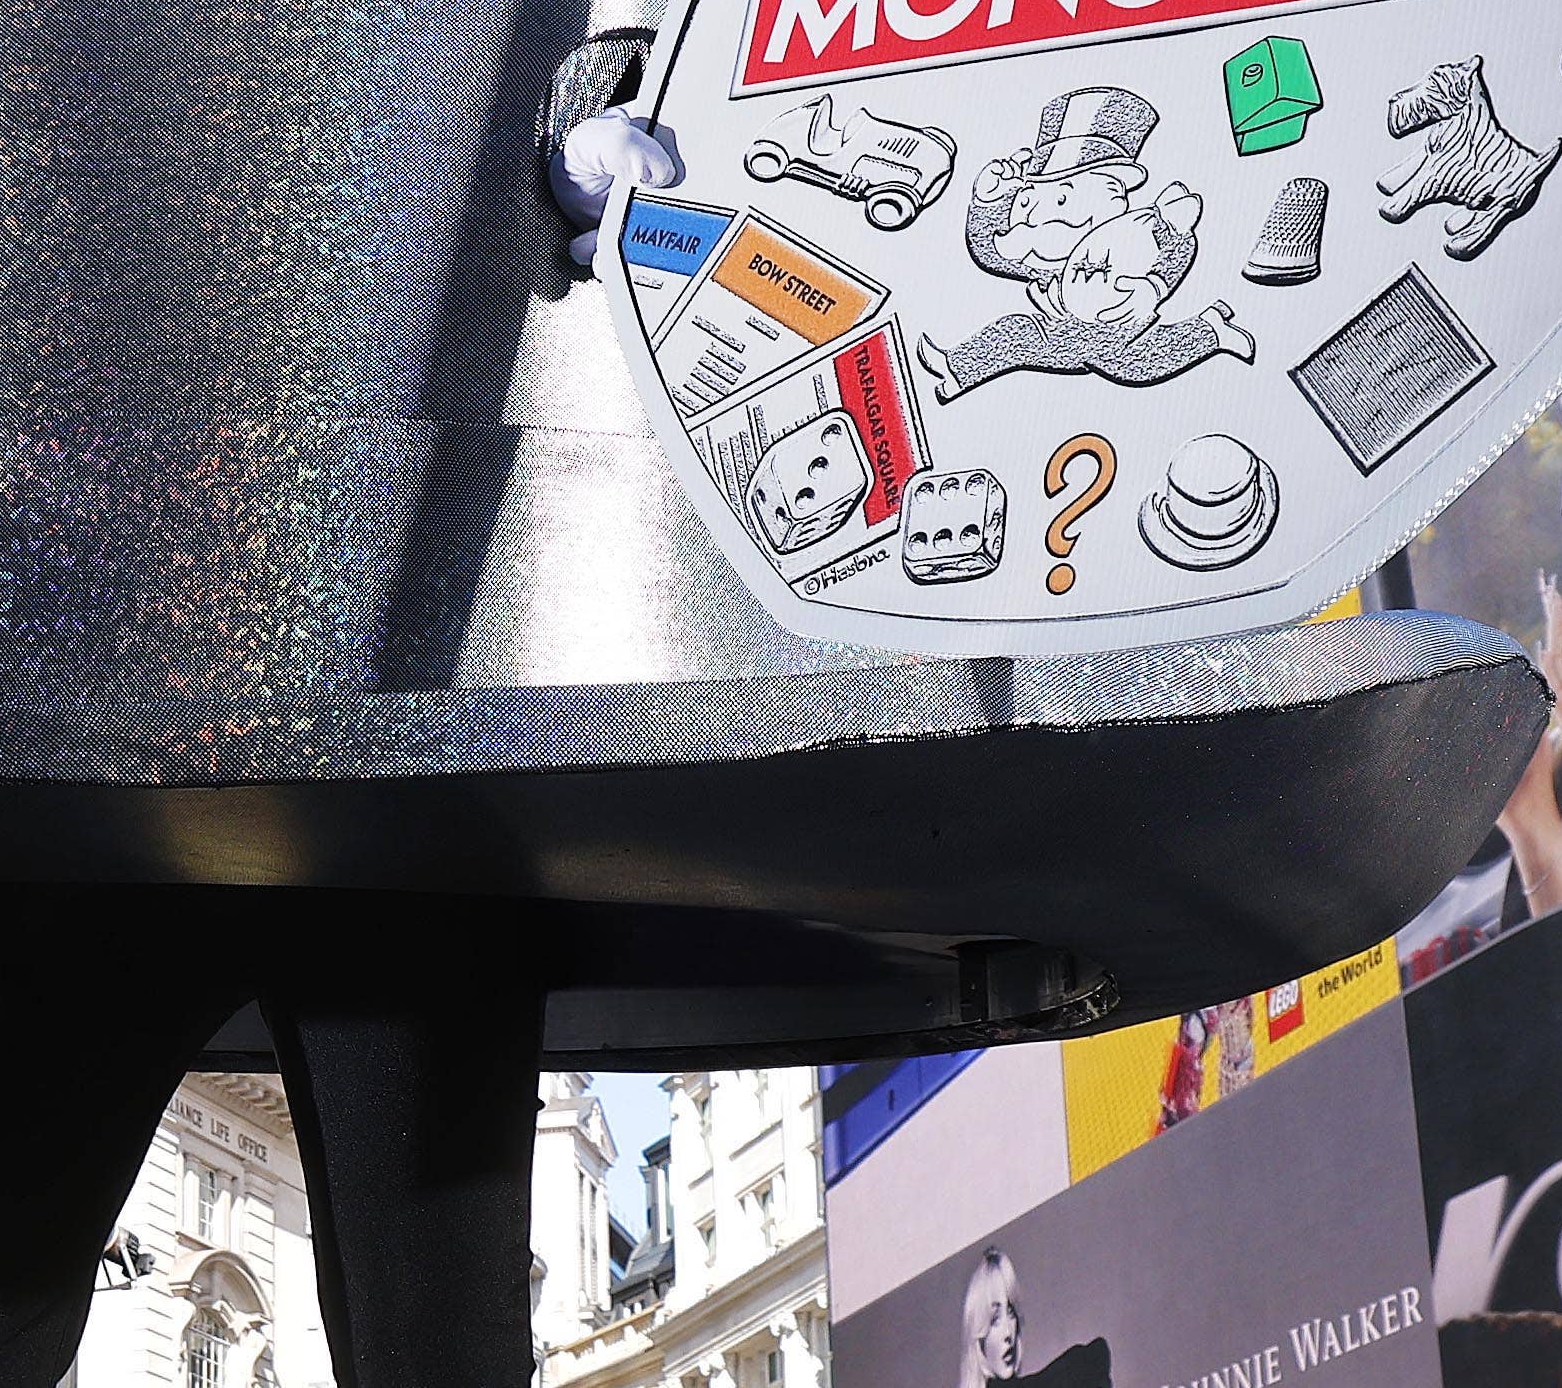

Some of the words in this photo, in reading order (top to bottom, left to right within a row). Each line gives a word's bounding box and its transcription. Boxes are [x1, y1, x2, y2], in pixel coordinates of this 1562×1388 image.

[631, 223, 704, 257] MAYFAIR
[747, 252, 785, 287] BOW
[782, 275, 837, 316] STREET
[851, 345, 885, 439] TRAFALGAR
[873, 438, 901, 510] SQUARE
[1318, 975, 1340, 999] the
[1341, 946, 1384, 986] World
[210, 1117, 231, 1143] LIFE
[238, 1132, 269, 1163] OFFICE
[1288, 1286, 1424, 1372] WALKER
